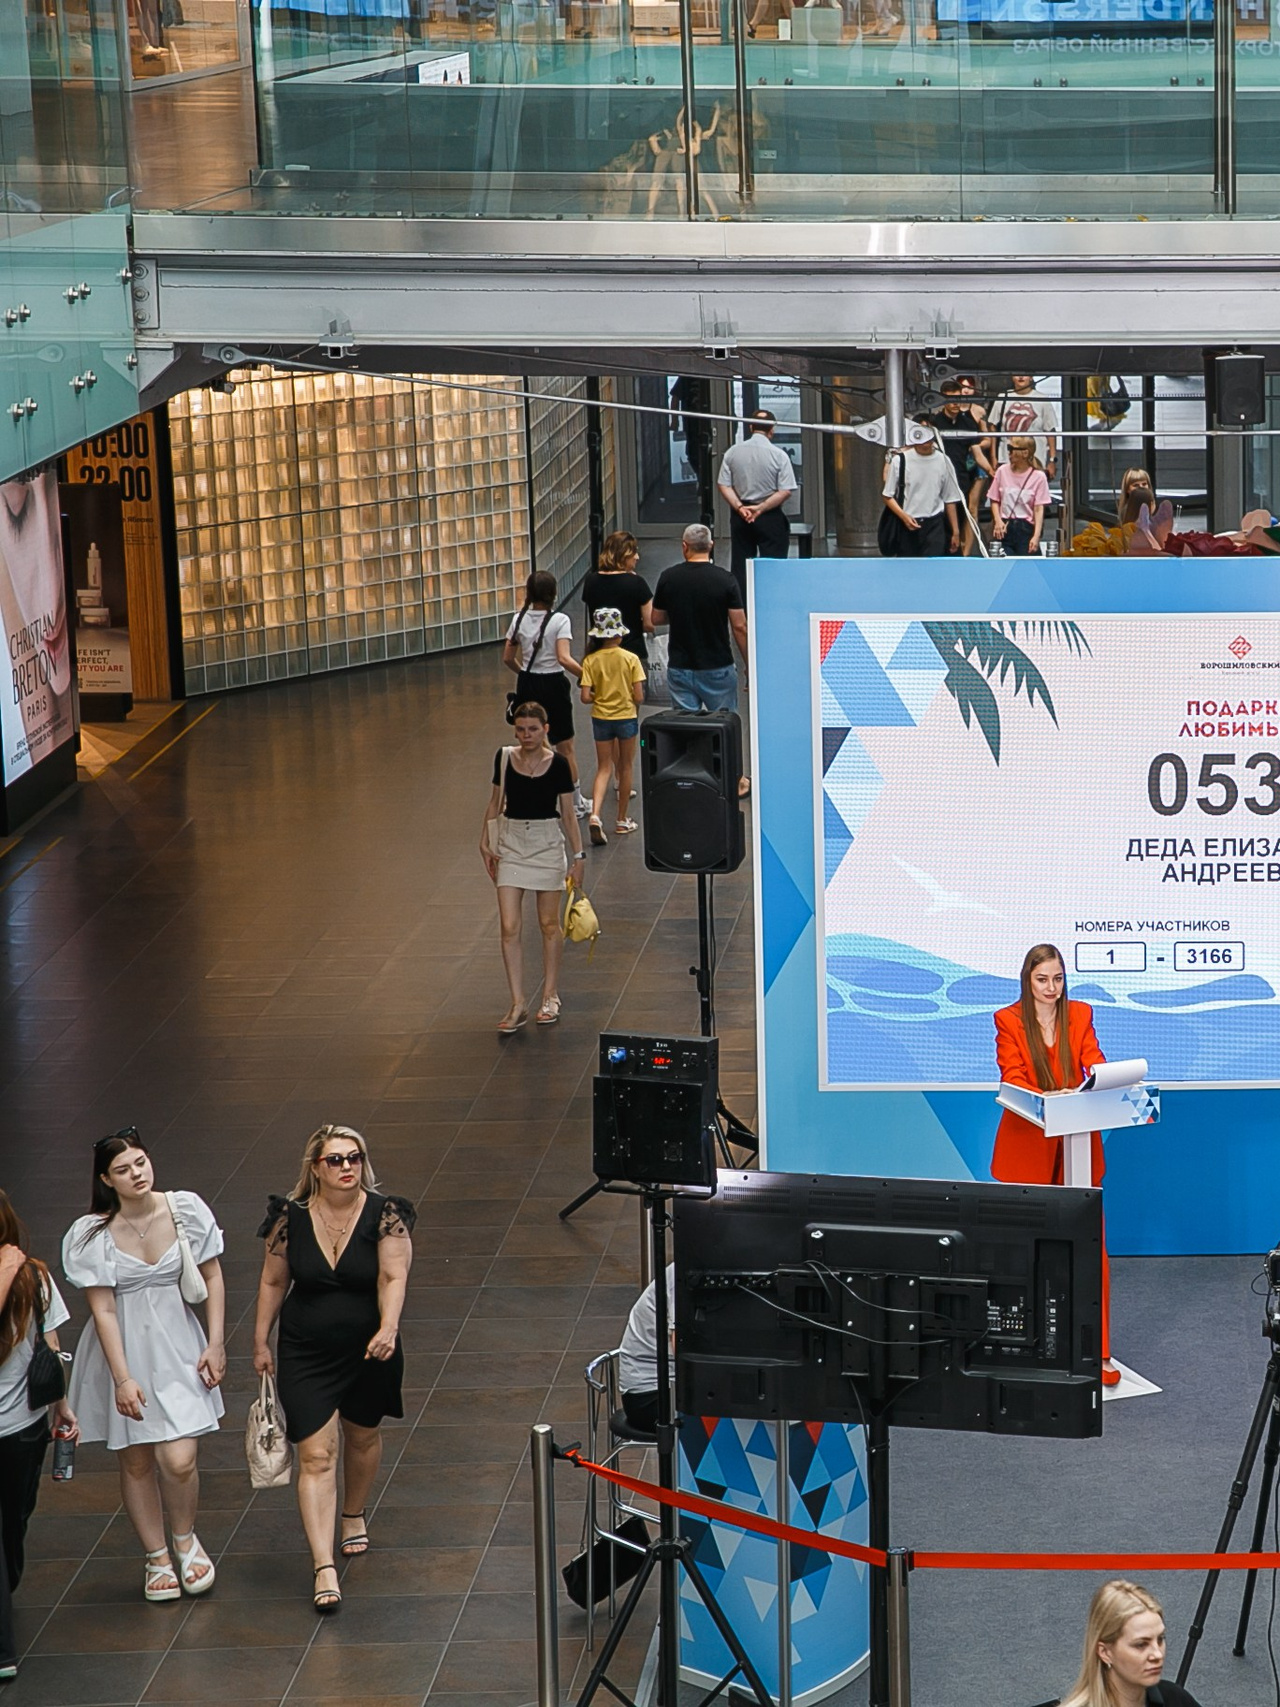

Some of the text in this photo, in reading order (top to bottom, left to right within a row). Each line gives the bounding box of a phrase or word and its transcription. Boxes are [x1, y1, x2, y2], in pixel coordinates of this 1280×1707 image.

[10, 610, 54, 660] CHRISTIAN
[77, 657, 108, 665] ERFECT,
[12, 646, 57, 705] BRETON
[27, 695, 47, 722] PARIS
[1126, 838, 1196, 861] ДЕДА
[1075, 920, 1230, 932] НОМЕРА УЧАСТНИКОВ
[1106, 949, 1115, 964] 1
[1187, 949, 1232, 964] 3166
